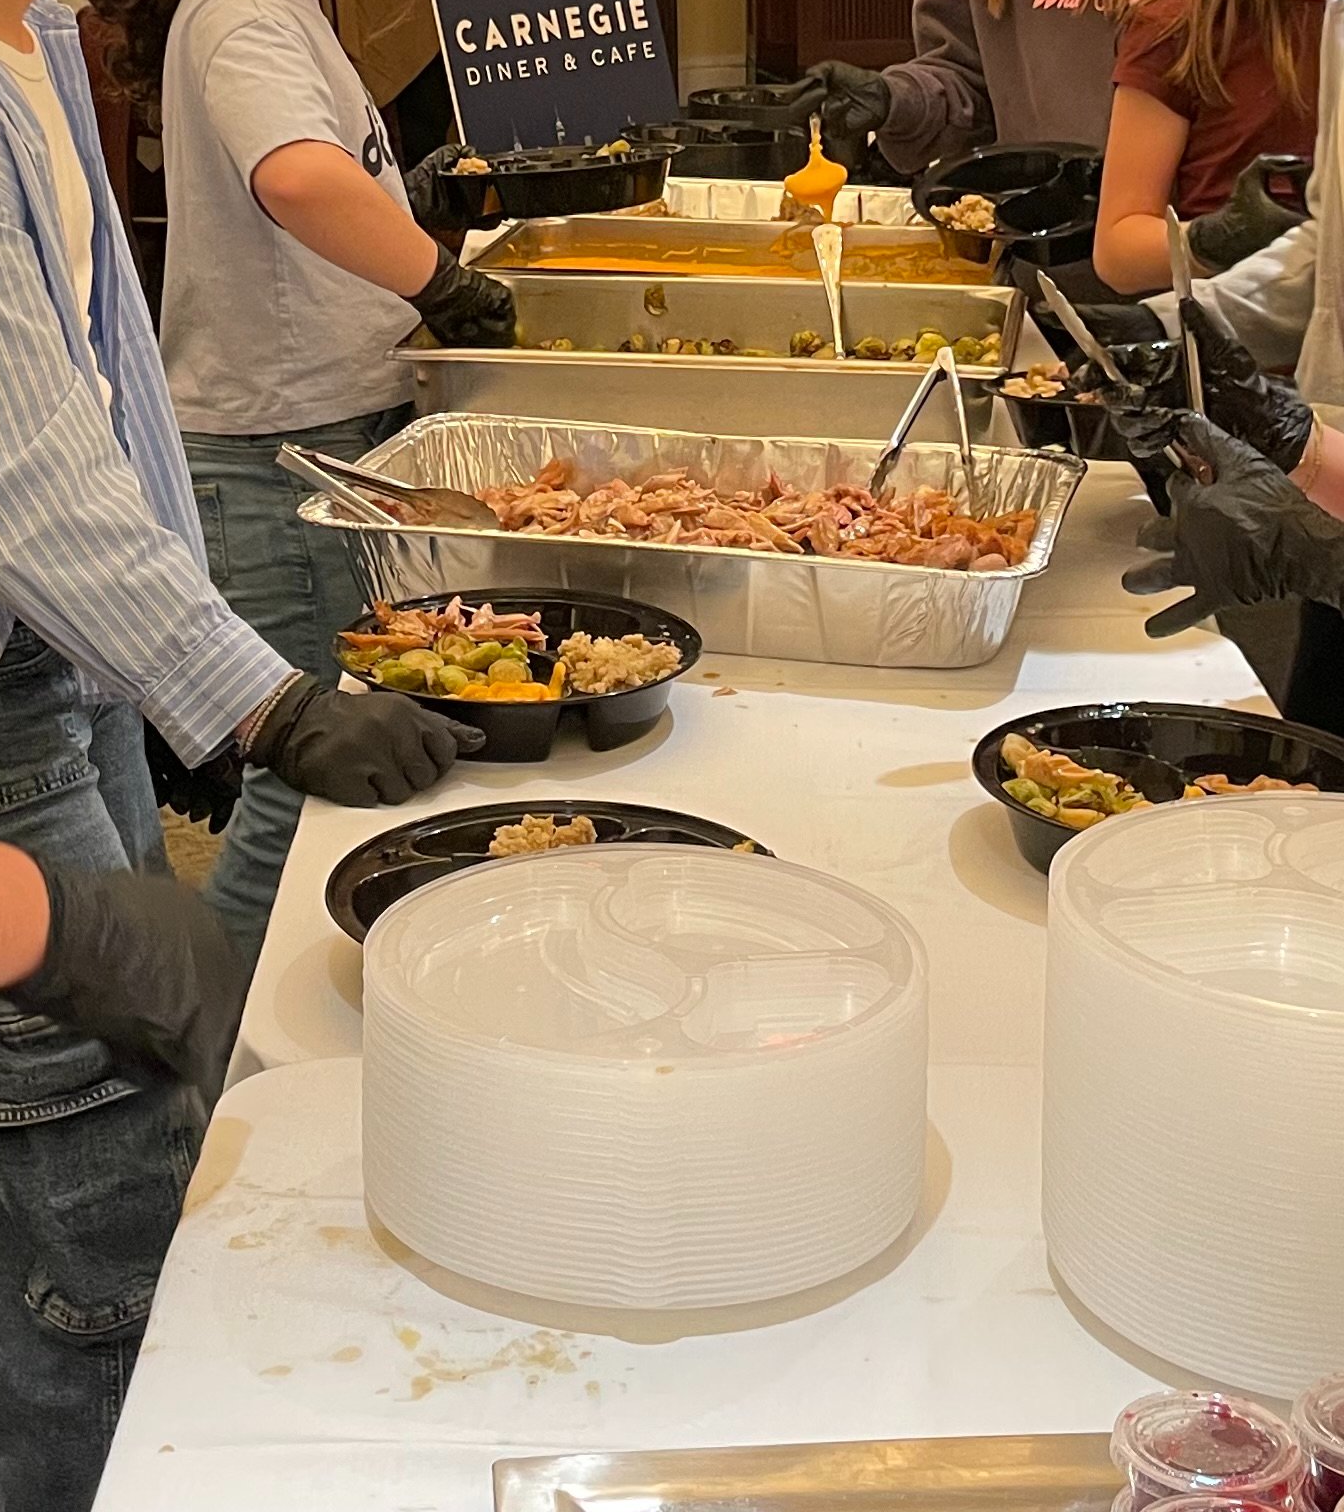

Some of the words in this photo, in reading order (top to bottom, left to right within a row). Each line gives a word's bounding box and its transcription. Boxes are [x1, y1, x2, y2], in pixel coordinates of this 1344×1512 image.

[465, 56, 549, 86] DINER
[564, 52, 578, 71] &
[591, 40, 656, 67] CAFE
